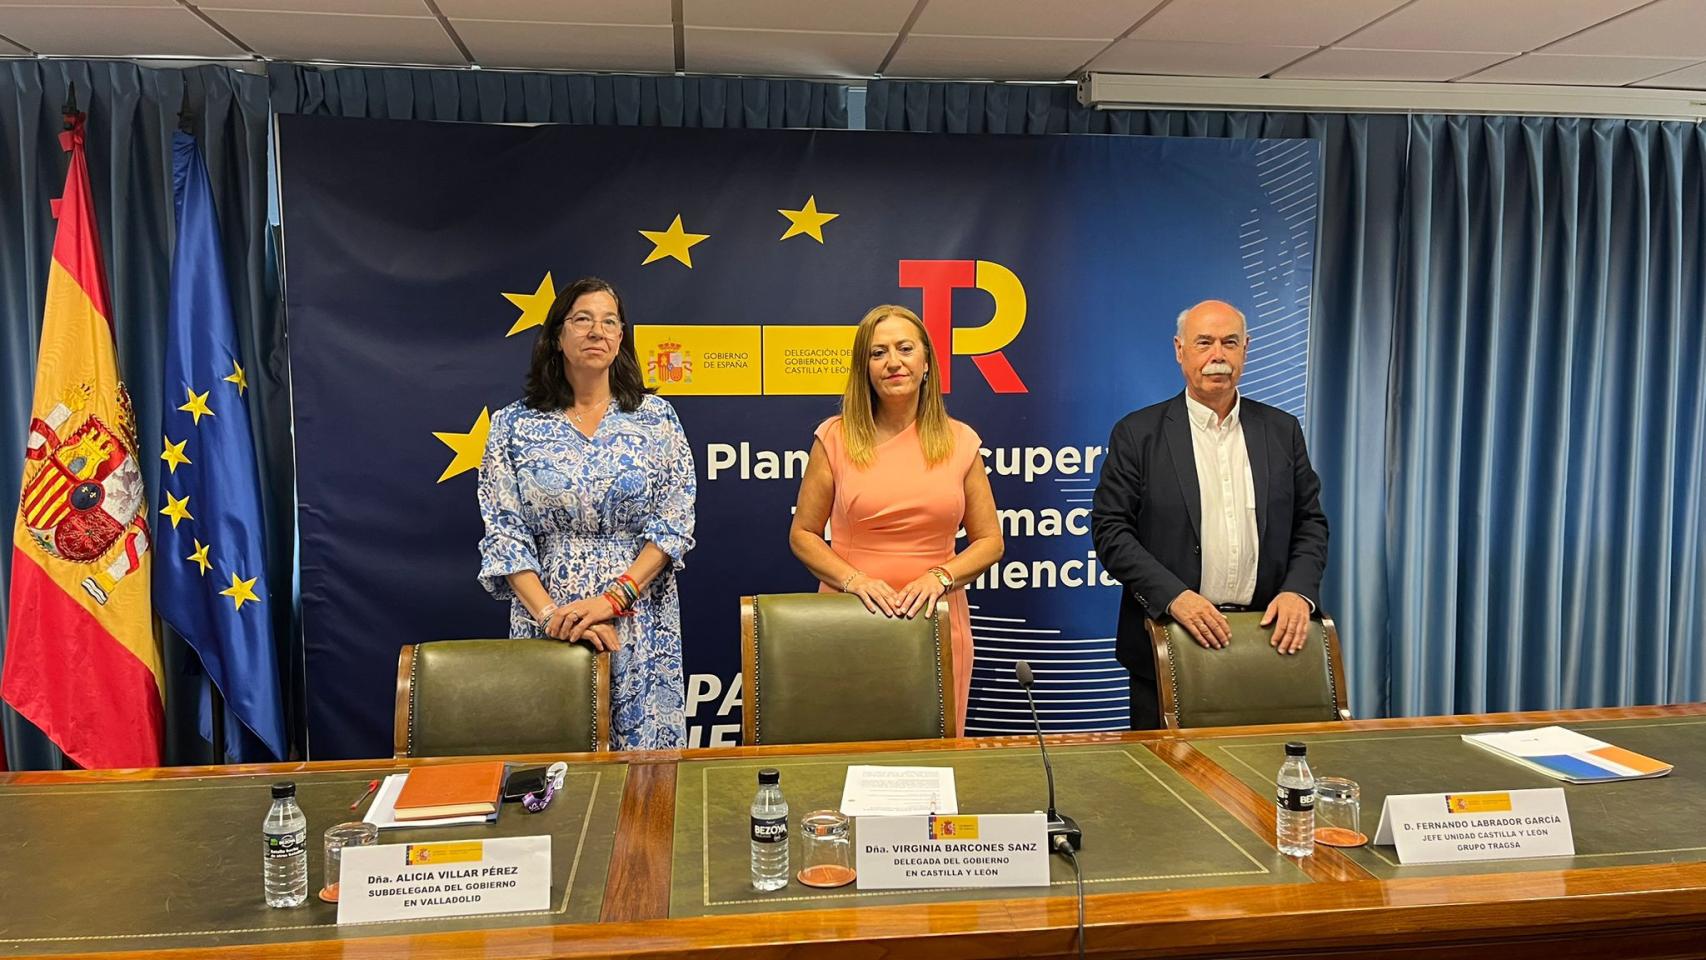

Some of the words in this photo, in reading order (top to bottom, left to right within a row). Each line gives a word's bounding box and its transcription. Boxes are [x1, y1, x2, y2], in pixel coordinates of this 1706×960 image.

[784, 348, 837, 356] DELEGACIÓN
[717, 360, 748, 368] ESPAÑA
[707, 442, 810, 480] Plan
[755, 823, 787, 835] BEZOYA
[1404, 823, 1414, 831] D.
[1416, 820, 1469, 831] FERNANDO
[1471, 818, 1522, 828] LABRADOR
[1422, 834, 1441, 842] JEFE
[1444, 833, 1476, 841] UNIDAD
[866, 845, 889, 854] Dña.
[892, 844, 942, 853] VIRGINIA
[945, 843, 1004, 853] BARCONES
[1007, 843, 1037, 852] SANZ
[1457, 843, 1486, 851] GRUPO
[1488, 841, 1521, 850] TRAGSA
[943, 857, 960, 865] DEL
[963, 857, 1010, 865] GOBIERNO
[368, 875, 393, 885] Dña.
[396, 872, 435, 883] ALICIA
[438, 869, 479, 879] VILLAR
[482, 866, 519, 877] PÉREZ
[920, 869, 964, 877] CASTILLA
[975, 868, 998, 876] LEÓN
[368, 885, 442, 897] SUBDELEGADA
[444, 883, 463, 892] DEL
[466, 880, 517, 890] GOBIERNO
[404, 899, 417, 907] EN
[420, 895, 482, 905] VALLADOLID
